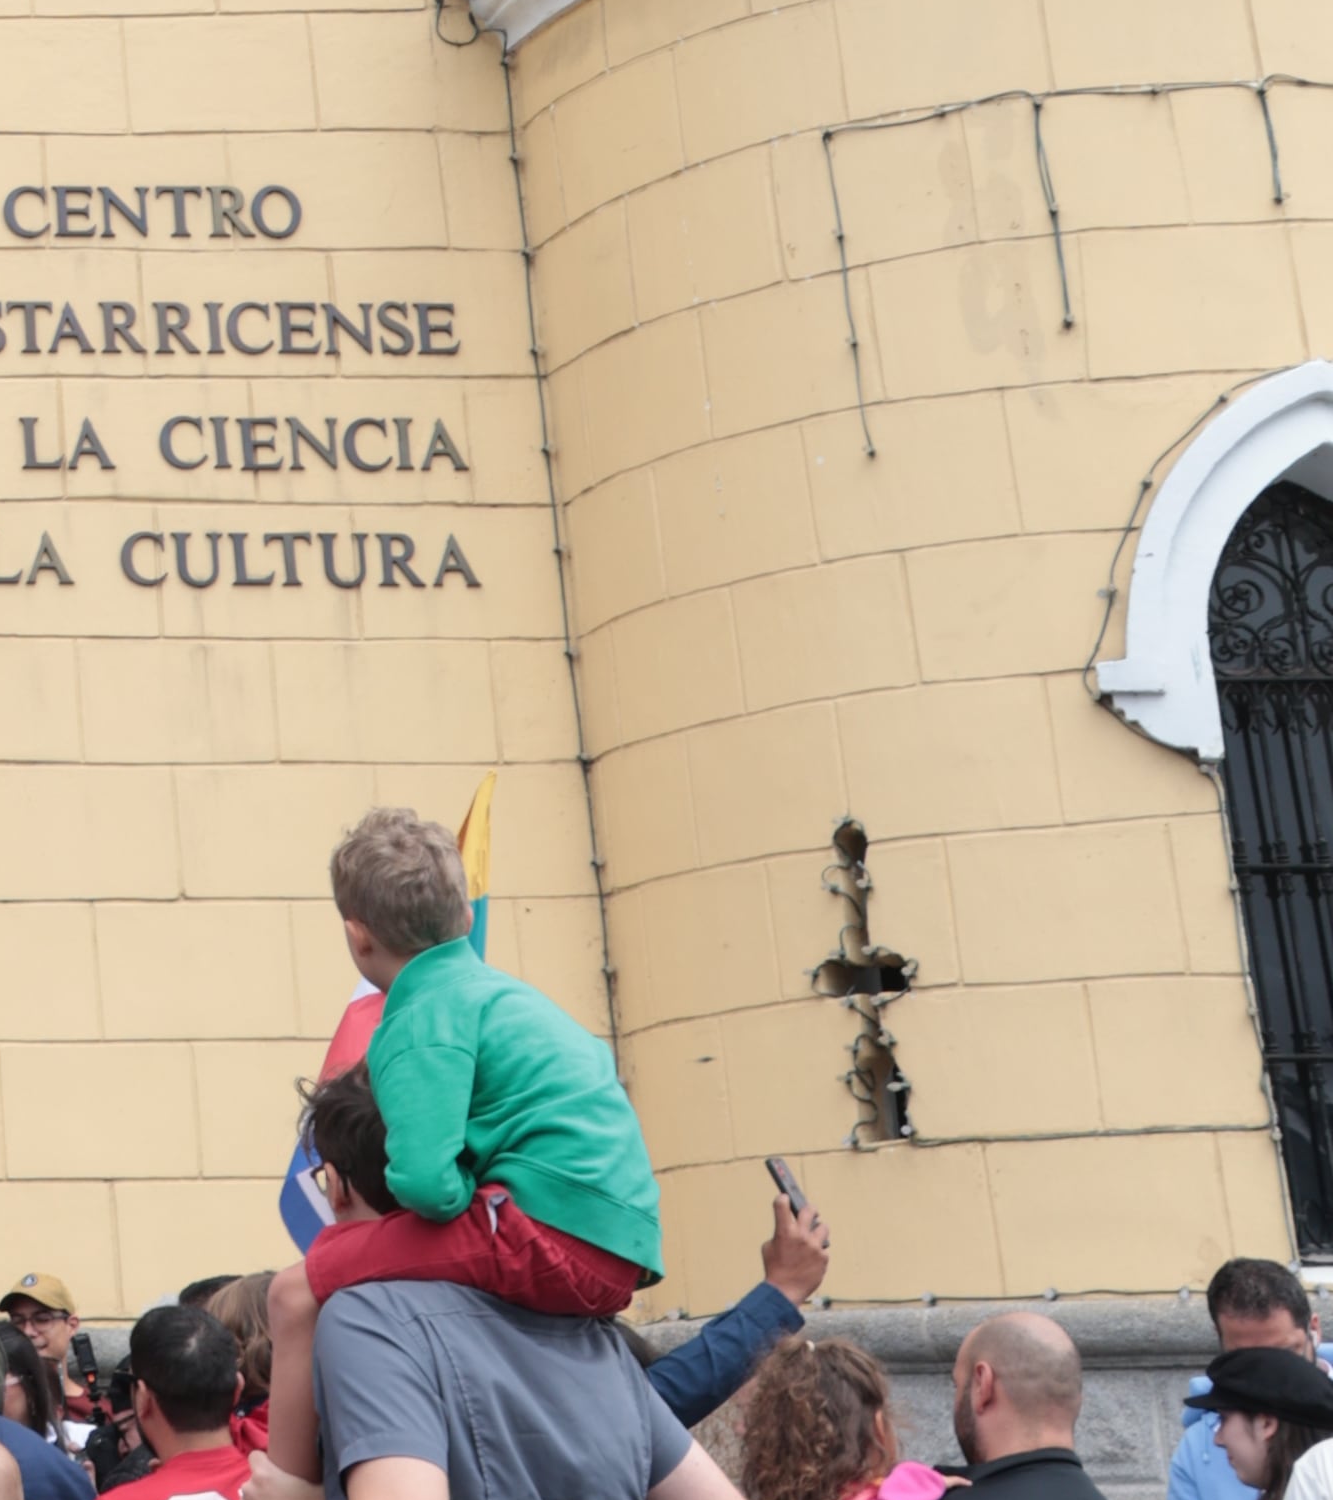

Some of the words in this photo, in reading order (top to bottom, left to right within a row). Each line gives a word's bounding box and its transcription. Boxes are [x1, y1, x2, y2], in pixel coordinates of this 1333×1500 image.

[2, 184, 303, 240] CENTRO
[18, 416, 117, 472] LA
[158, 415, 470, 473] CIENCIA
[119, 530, 483, 589] CULTURA
